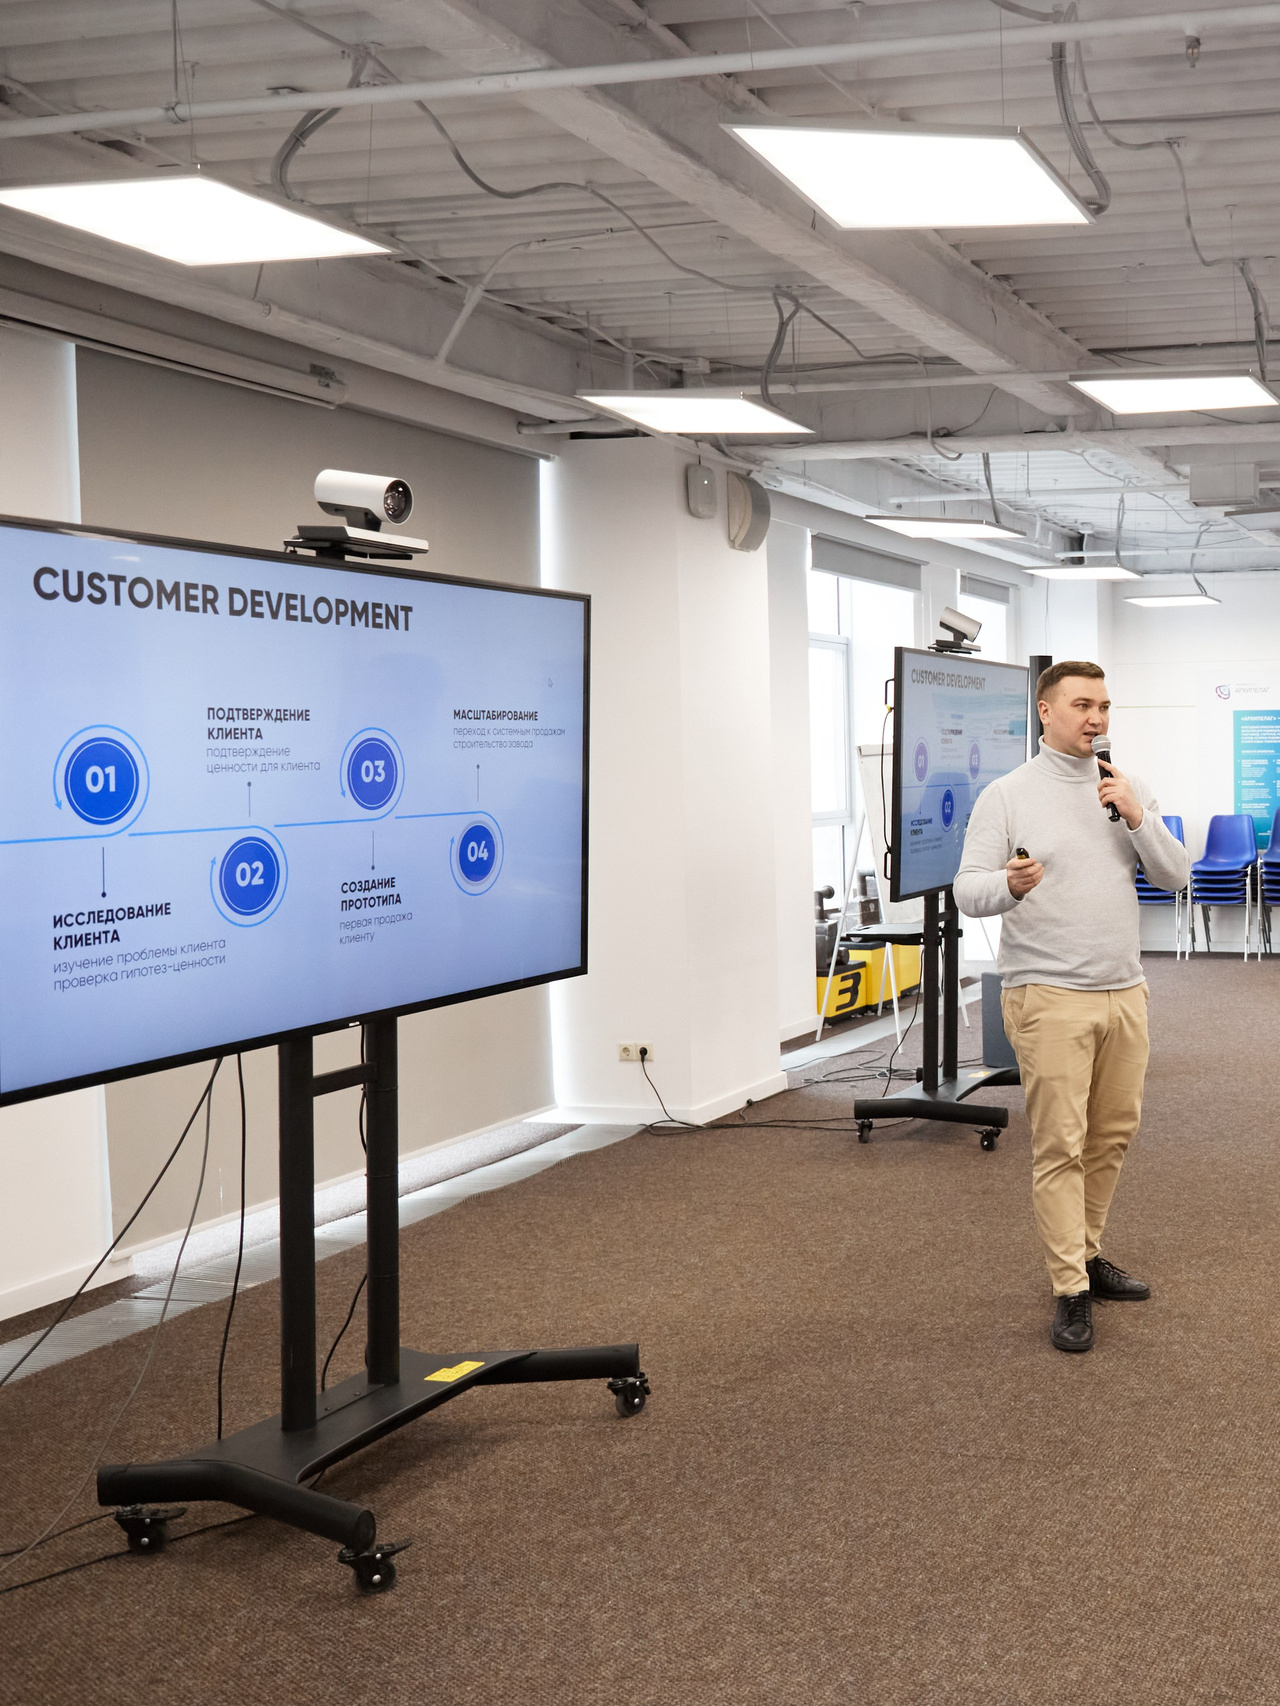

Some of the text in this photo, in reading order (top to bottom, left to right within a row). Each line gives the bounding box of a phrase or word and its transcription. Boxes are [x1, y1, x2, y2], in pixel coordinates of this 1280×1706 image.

[33, 566, 413, 631] CUSTOMER DEVELOPMENT
[911, 668, 986, 691] CUSTOMER DEVELOPMENT
[207, 707, 311, 723] ПОДТВЕРЖДЕНИЕ
[453, 709, 538, 721] МАСШТАБИРОВАНИЕ
[207, 727, 264, 740] КЛИЕНТА
[453, 727, 486, 738] переход
[492, 728, 530, 736] системным
[531, 728, 566, 737] продажам
[206, 746, 291, 759] подтверждение
[453, 740, 533, 750] строительство завода
[206, 761, 321, 774] ценности для клиента
[917, 755, 925, 767] 01
[85, 765, 116, 793] 01
[361, 760, 386, 782] 03
[944, 801, 952, 814] 02
[467, 841, 489, 862] 04
[235, 860, 264, 887] 02
[341, 877, 396, 894] СОЗДАНИЕ
[341, 893, 402, 912] ПРОТОТИПА
[53, 902, 171, 929] ИССЛЕДОВАНИЕ
[340, 912, 413, 931] первая продажа
[53, 929, 120, 951] КЛИЕНТА
[340, 932, 375, 944] клиенту
[53, 939, 226, 974] изучение проблемы клиента
[54, 954, 226, 992] проверка гипотез-ценности
[835, 971, 861, 1012] 3
